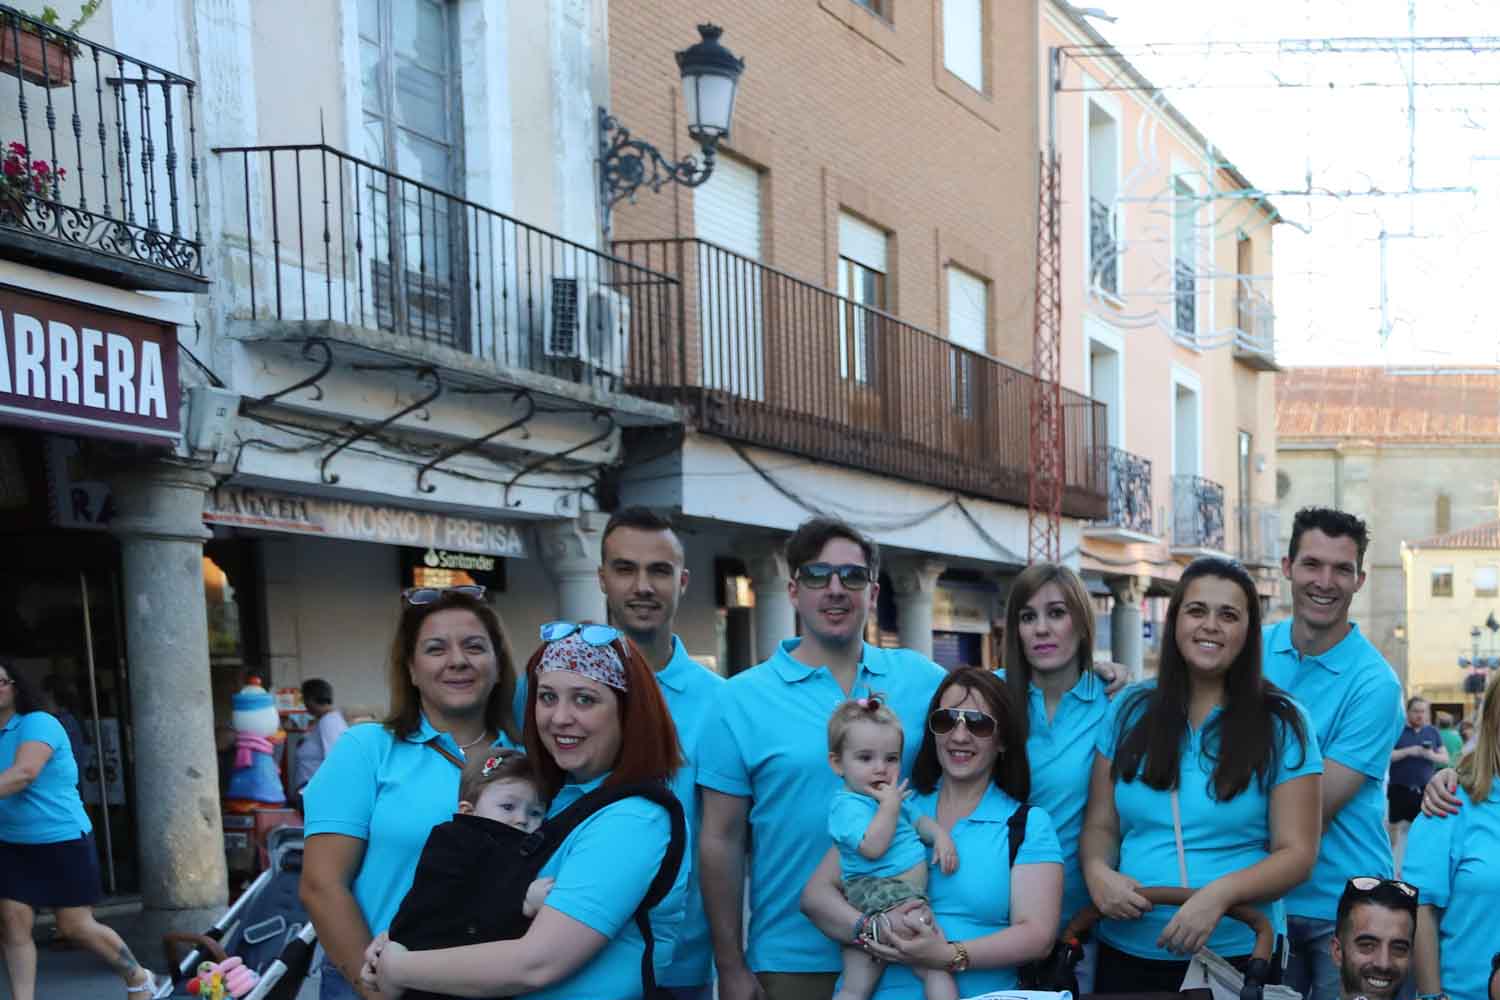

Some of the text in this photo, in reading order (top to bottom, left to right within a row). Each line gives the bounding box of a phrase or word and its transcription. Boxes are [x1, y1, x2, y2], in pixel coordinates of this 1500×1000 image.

[336, 504, 523, 553] KIOSKO Y PRENSA
